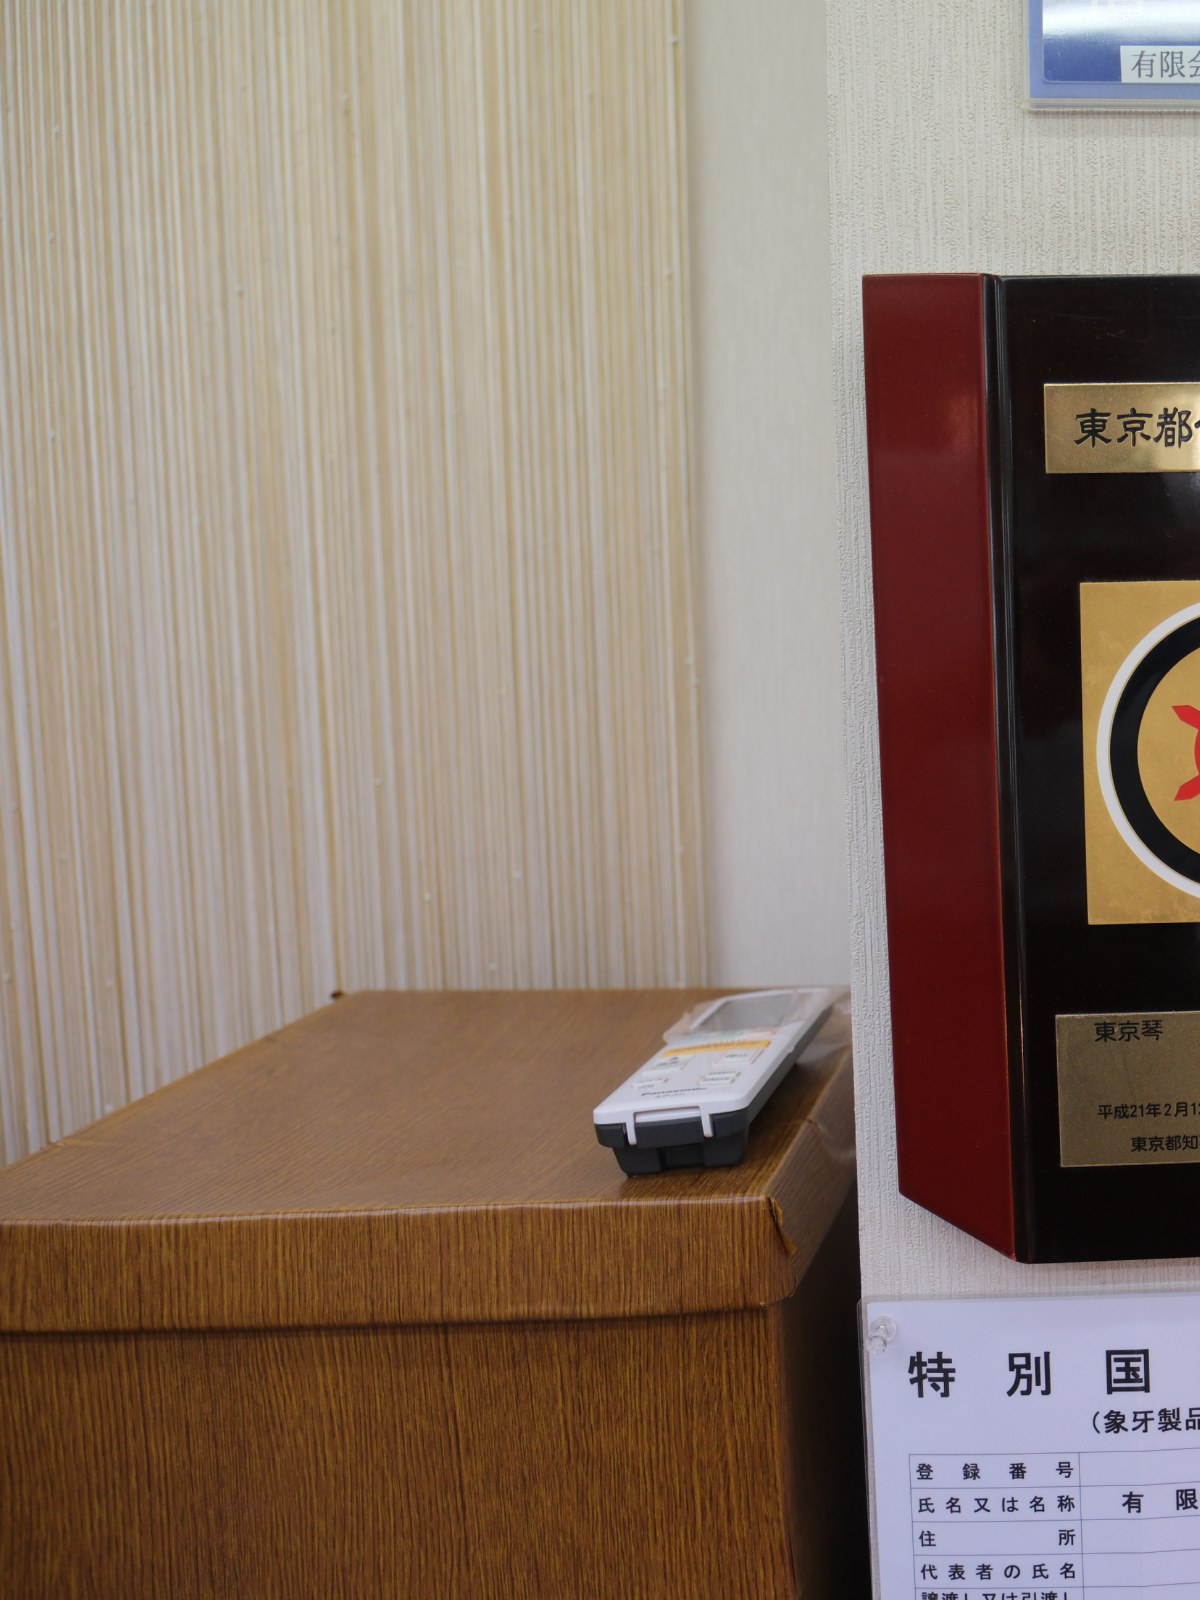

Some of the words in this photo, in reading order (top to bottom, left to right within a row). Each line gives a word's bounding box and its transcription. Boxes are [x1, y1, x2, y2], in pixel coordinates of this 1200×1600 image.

[1094, 1019, 1164, 1043] 東京琴
[916, 1461, 1074, 1481] 登録番号
[917, 1494, 1076, 1514] 氏名又は名称
[920, 1562, 1076, 1581] 代表者の氏名
